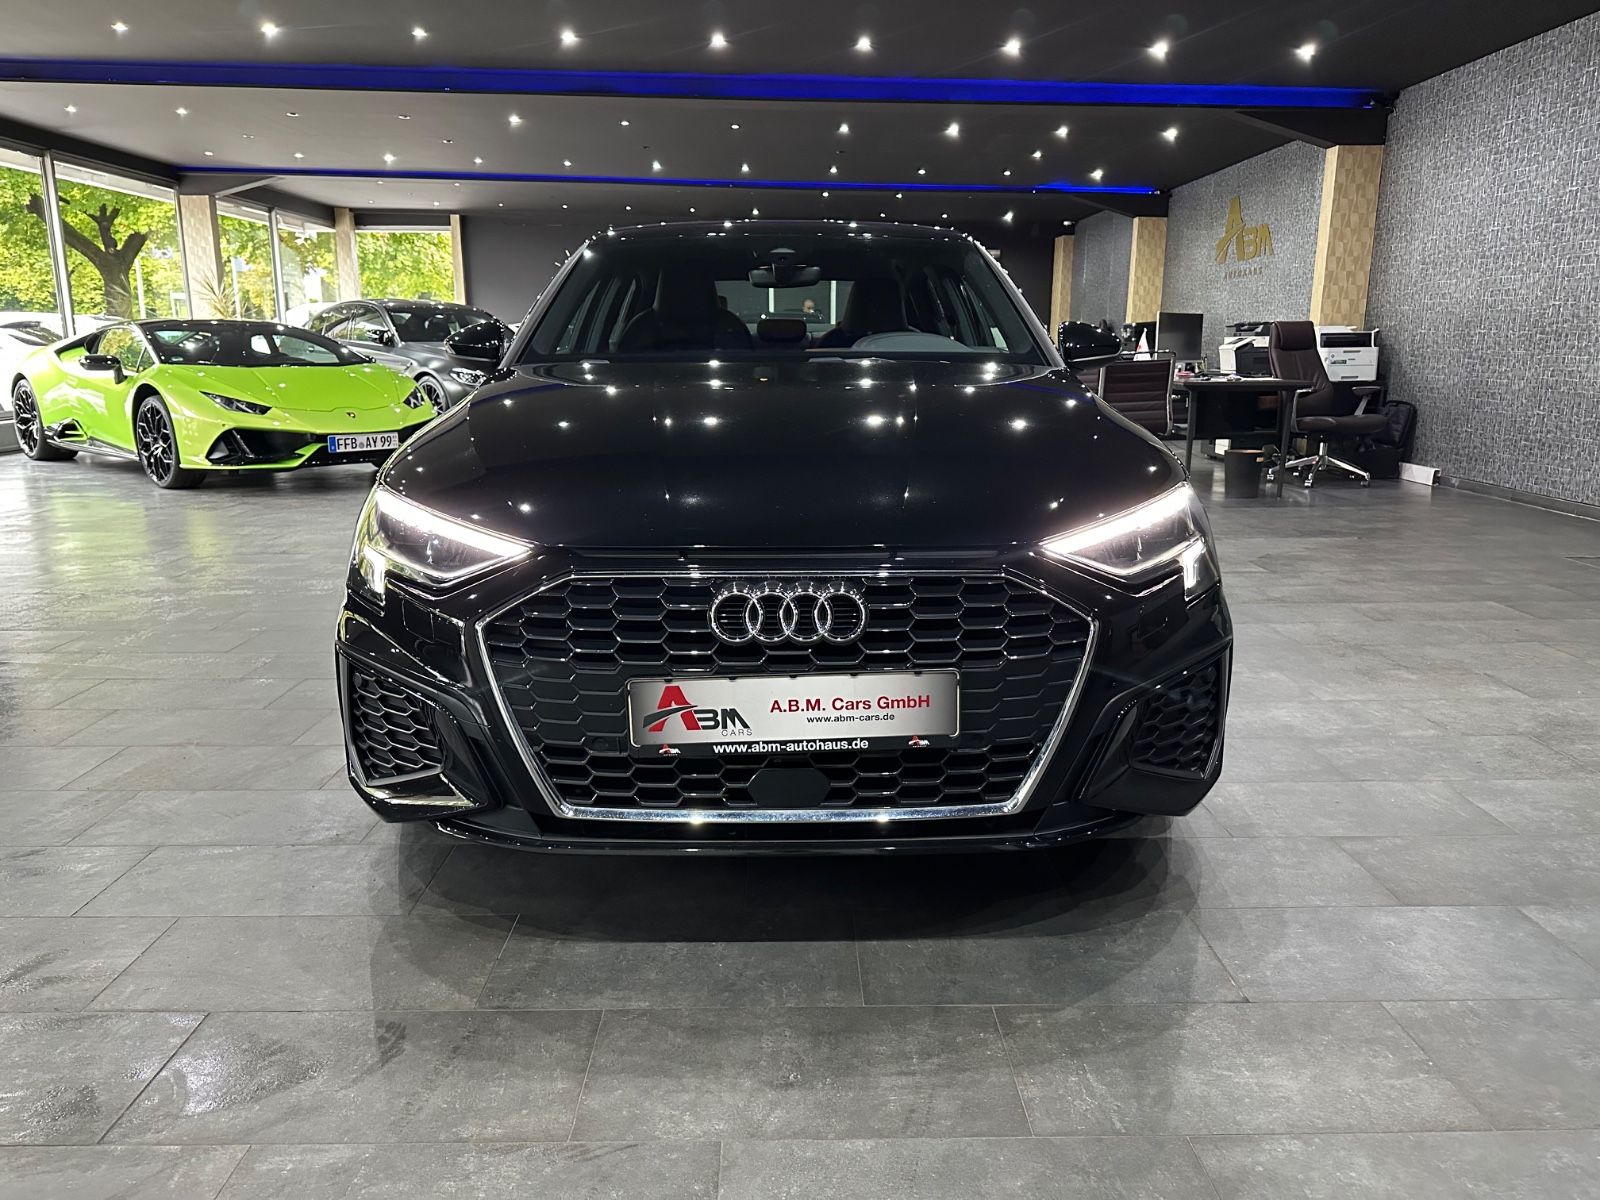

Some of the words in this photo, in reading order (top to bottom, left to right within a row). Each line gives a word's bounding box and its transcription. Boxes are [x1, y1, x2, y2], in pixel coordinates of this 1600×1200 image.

[1215, 196, 1274, 264] ABM
[336, 437, 357, 450] FFB
[366, 436, 378, 448] AY
[380, 435, 392, 447] 99
[643, 686, 751, 732] ABM
[770, 698, 826, 713] A.B.M.
[832, 697, 872, 711] Cars
[877, 695, 930, 709] GmbH
[807, 713, 895, 723] www.abm-cars.de
[721, 729, 753, 737] CARS
[713, 738, 869, 753] www.abm-autohaus.de
